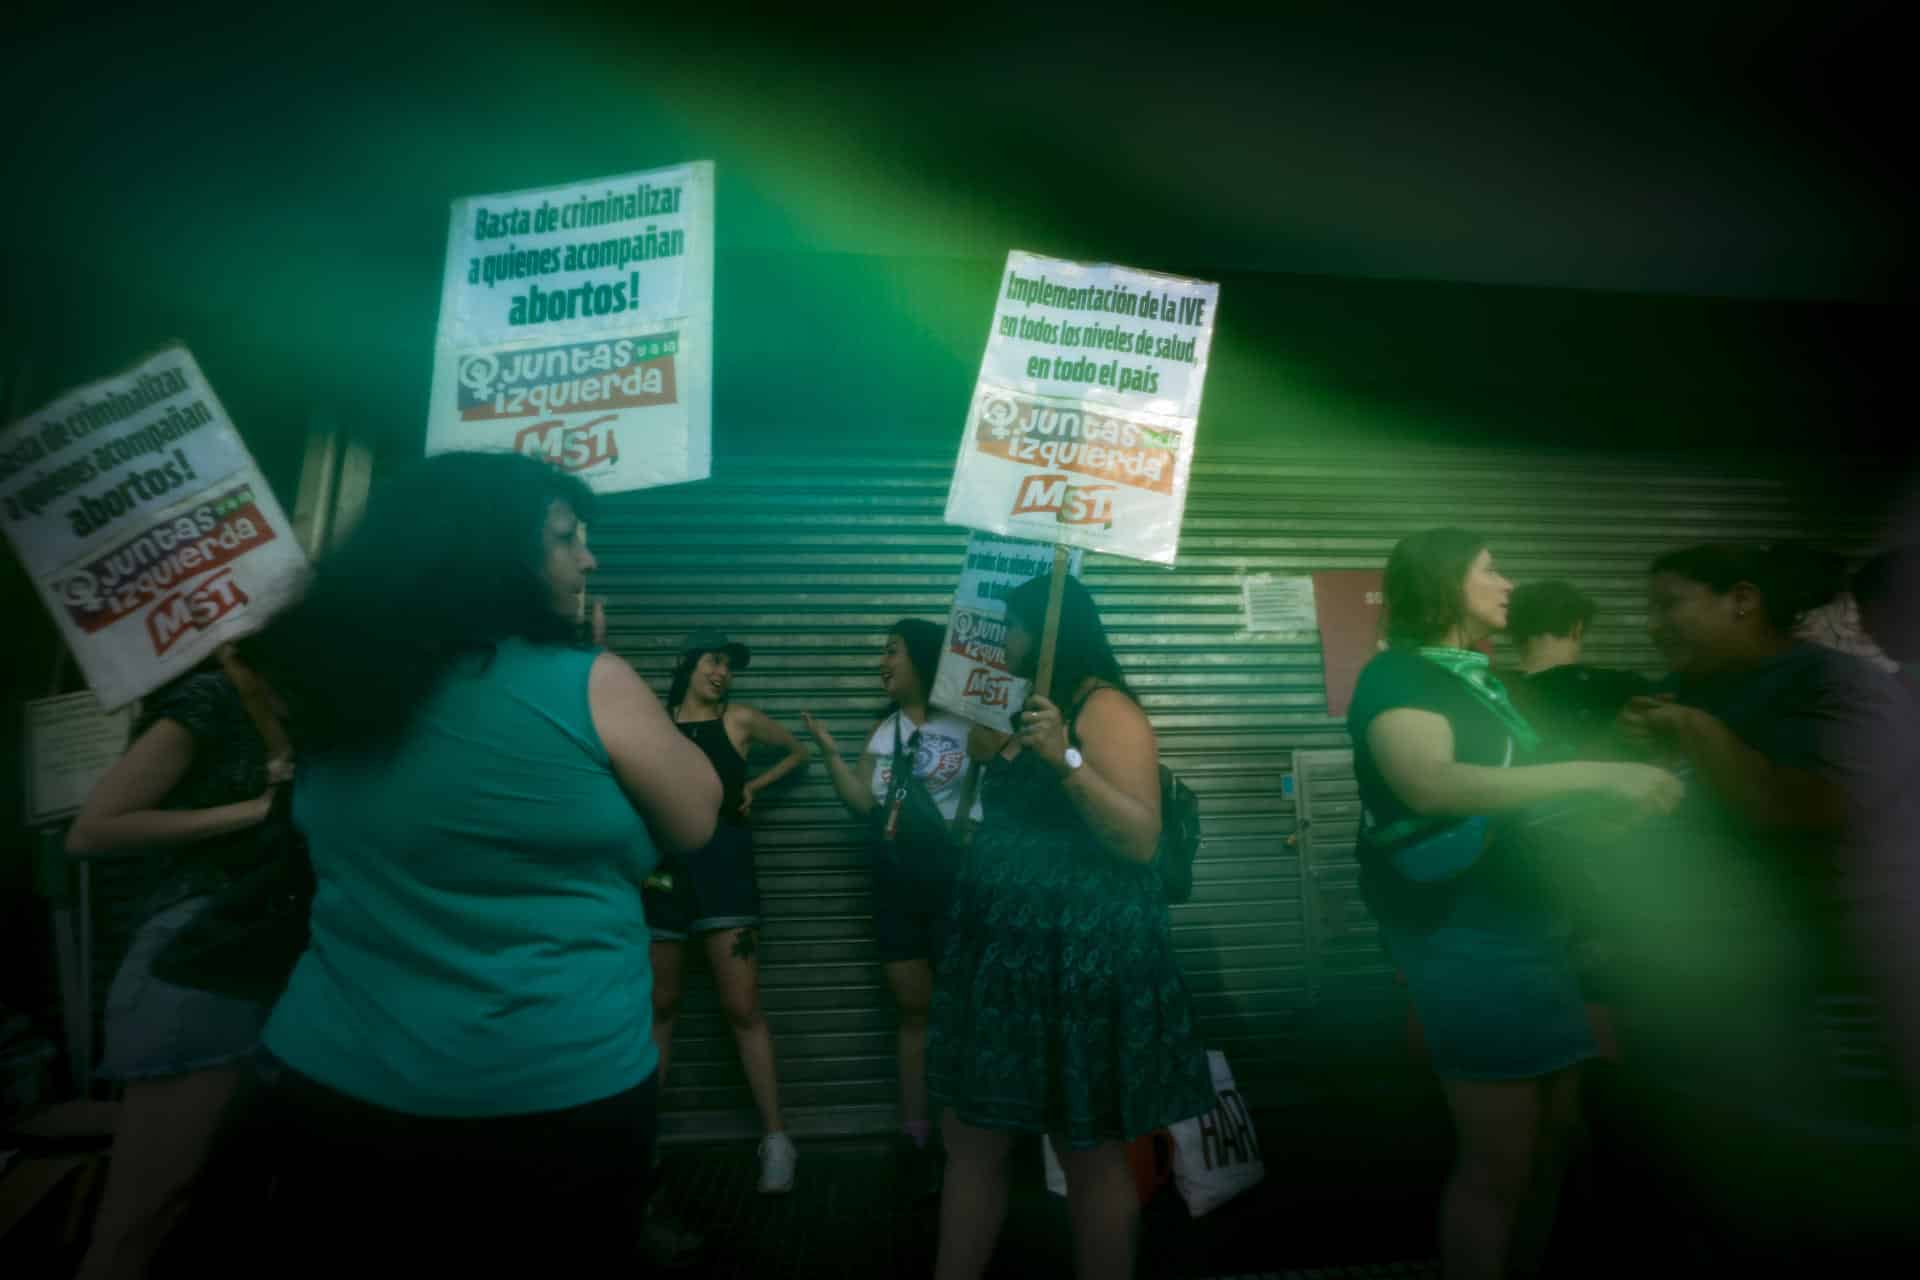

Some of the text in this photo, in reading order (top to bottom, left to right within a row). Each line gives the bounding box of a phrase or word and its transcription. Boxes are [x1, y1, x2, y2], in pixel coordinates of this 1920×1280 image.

[475, 184, 682, 240] Basta de criminalizar
[469, 225, 684, 288] a quienes acompañan
[508, 271, 639, 325] abortos!
[1006, 271, 1207, 327] Implementación de la IVE
[1000, 314, 1198, 367] en todos los niveles de salud,
[494, 367, 663, 417] izquierda
[1027, 356, 1160, 393] en todo el país
[514, 415, 619, 472] MST
[1008, 432, 1164, 480] izquierda
[65, 449, 197, 537] abortos!
[1015, 475, 1118, 528] MST
[149, 570, 249, 655] MST
